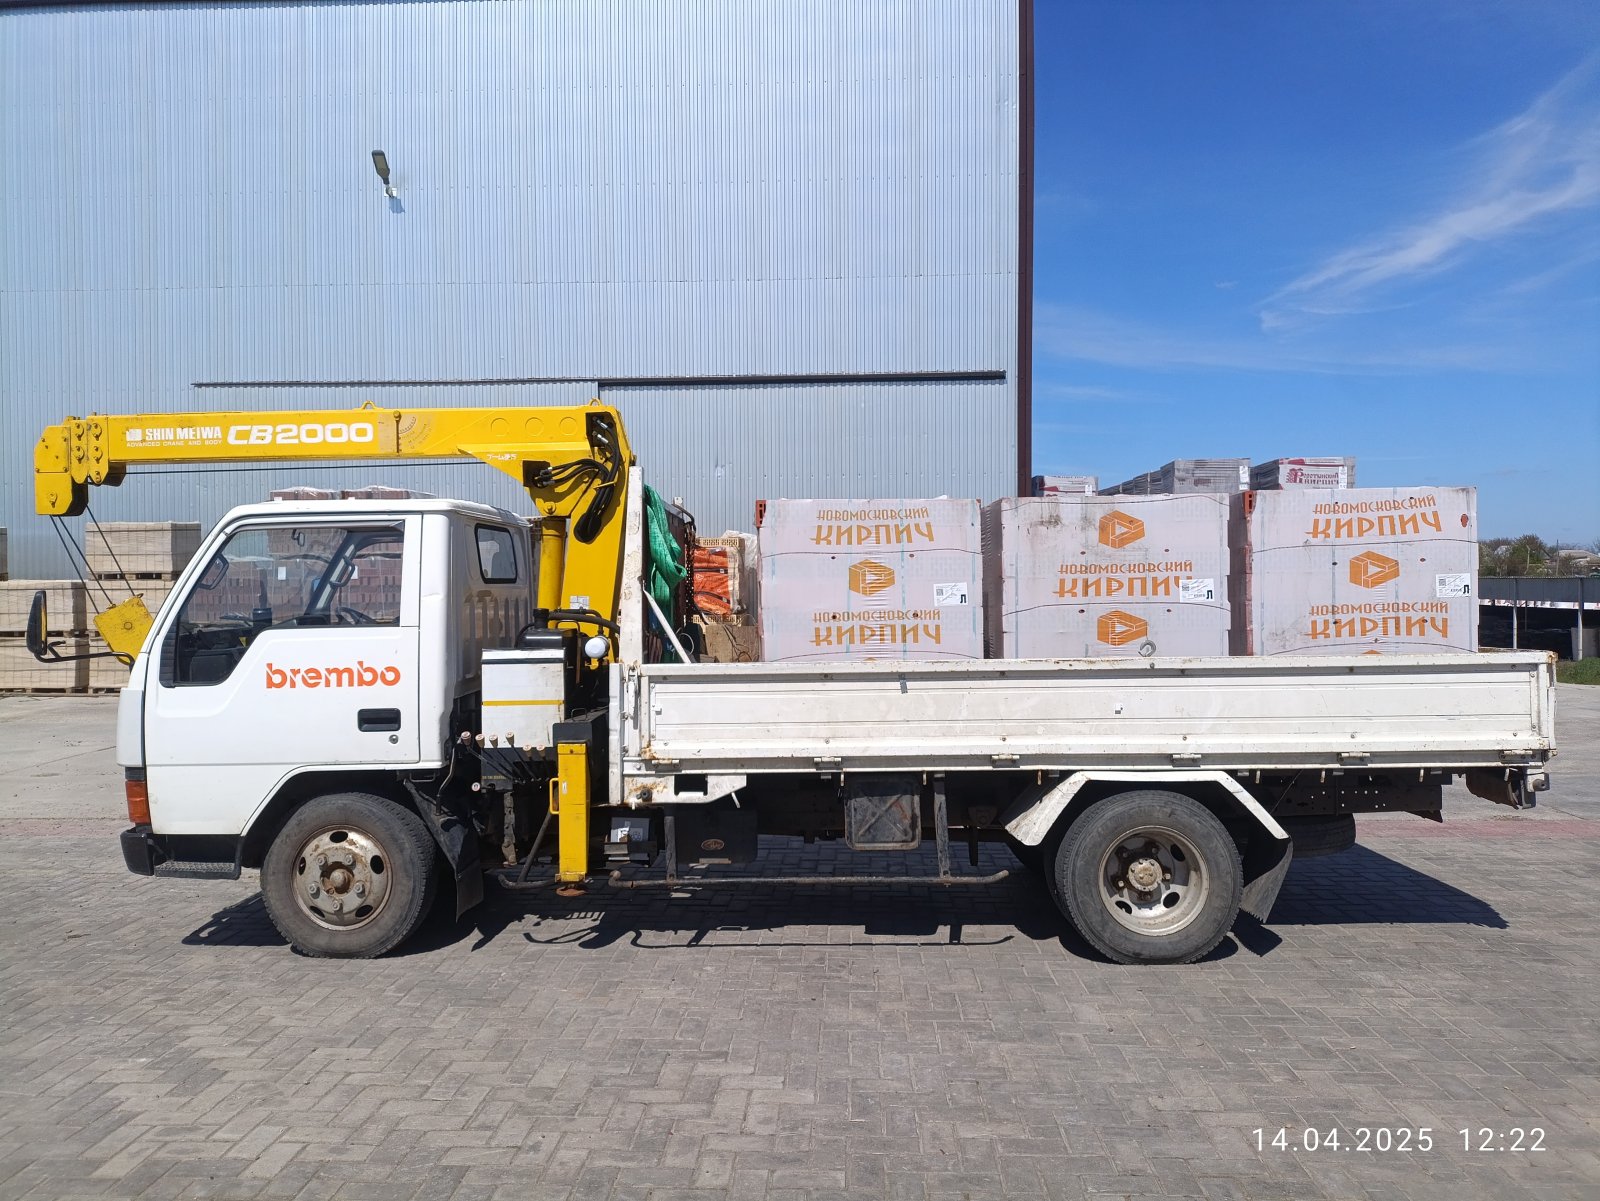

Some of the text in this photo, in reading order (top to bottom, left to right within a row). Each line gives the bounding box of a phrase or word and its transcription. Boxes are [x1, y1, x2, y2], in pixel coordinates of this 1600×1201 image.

[145, 426, 222, 441] SHIN MEIWA
[227, 422, 373, 445] CB2000
[816, 507, 929, 521] НОВОМОСКОВСКИЙ
[1312, 494, 1437, 515] НОВОМОСКОВСКИЙ
[809, 522, 935, 546] КИРПИЧ
[1304, 510, 1442, 539] КИРПИЧ
[1057, 559, 1193, 575] НОВОМОСКОВСКИЙ
[813, 609, 941, 623] НОВОМОСКОВСКИЙ
[1309, 601, 1449, 616] НОВОМОСКОВСКИЙ
[809, 623, 941, 647] КИРПИЧ
[1304, 616, 1448, 640] КИРПИЧ
[266, 660, 401, 689] brembo
